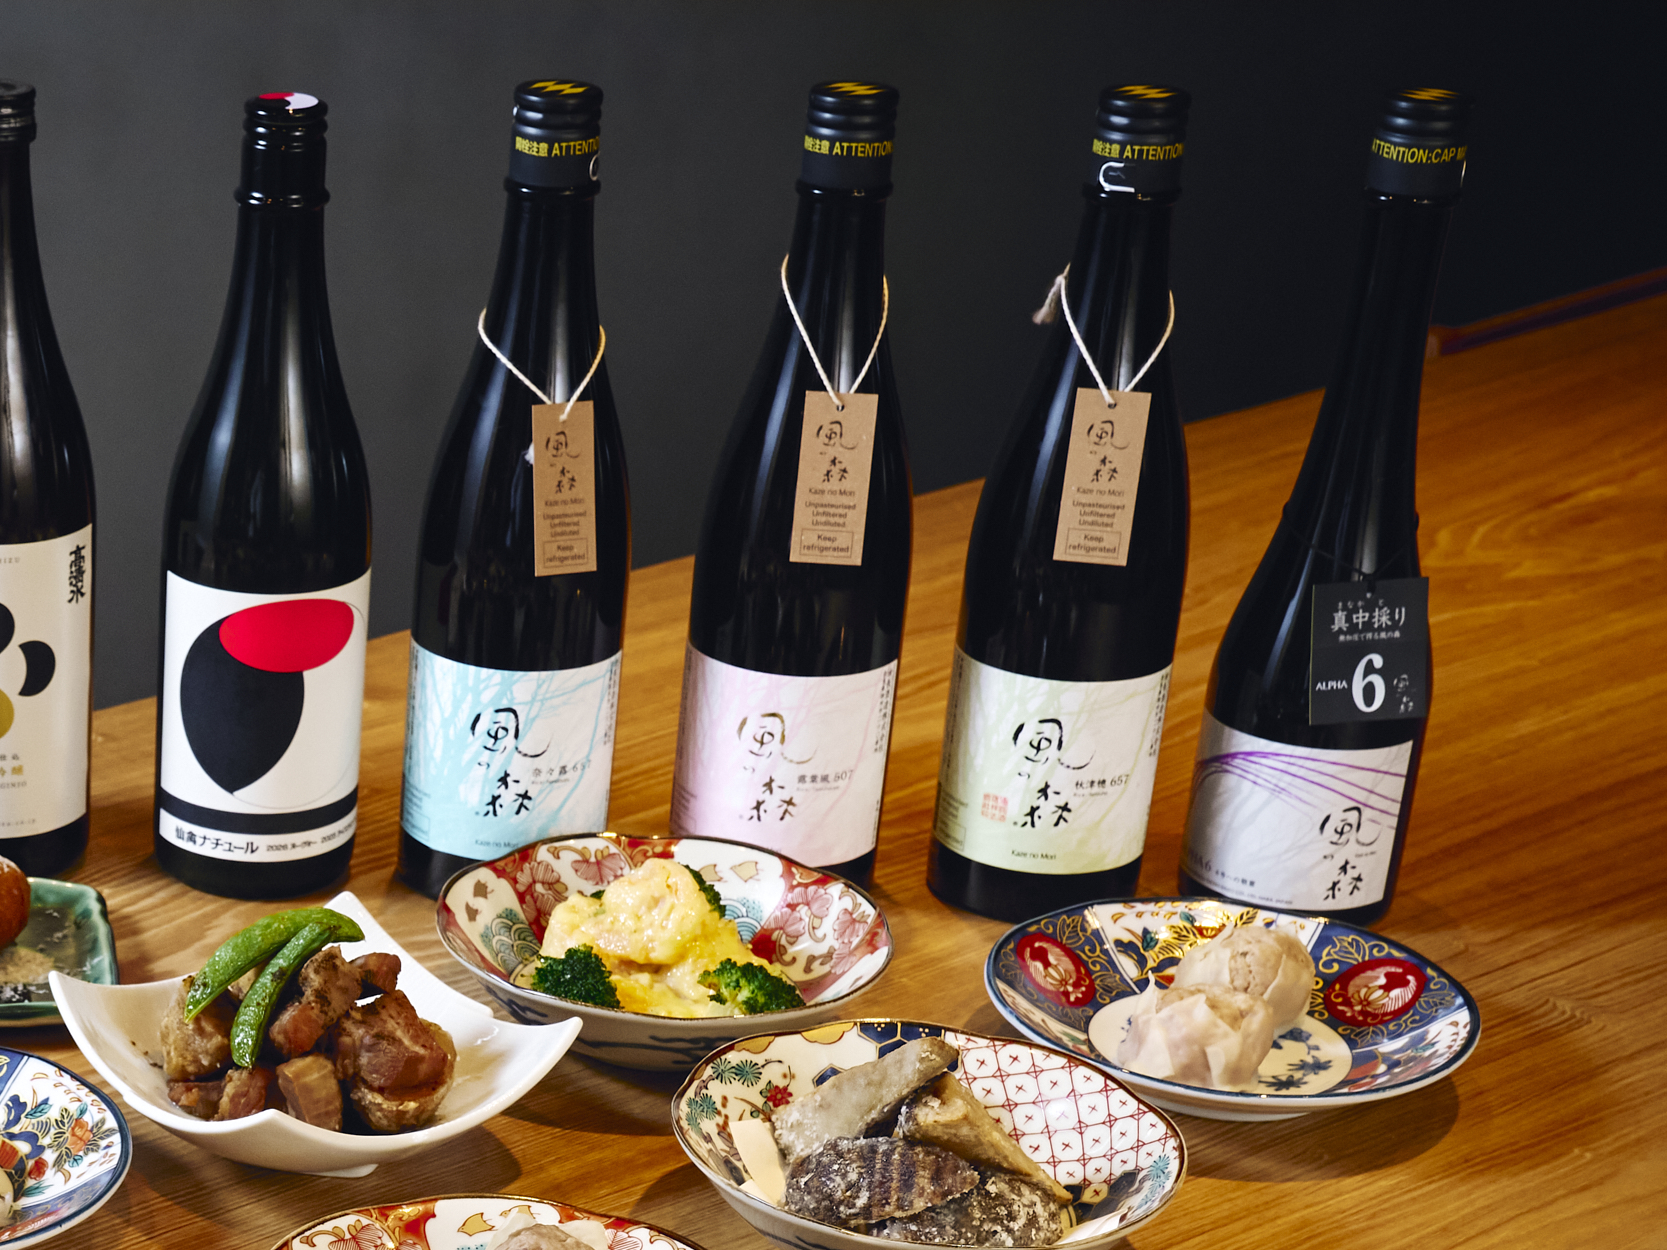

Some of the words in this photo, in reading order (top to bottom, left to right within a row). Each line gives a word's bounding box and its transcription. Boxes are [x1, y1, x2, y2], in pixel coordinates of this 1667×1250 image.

[809, 487, 825, 496] Kaze
[827, 488, 837, 496] no
[1076, 486, 1094, 495] Kaze
[1096, 488, 1107, 496] no
[812, 510, 848, 519] Unfiltered
[1079, 509, 1115, 519] Unfiltered
[812, 519, 846, 528] Undiluted
[1078, 519, 1114, 528] Undiluted
[817, 533, 838, 543] Keep
[1084, 533, 1104, 543] Keep
[803, 542, 850, 554] refrigerated
[1068, 542, 1117, 554] refrigerated
[1331, 606, 1406, 632] 真中採り
[1316, 680, 1348, 691] ALPHA
[1352, 653, 1386, 713] 6
[833, 769, 854, 783] 507
[1110, 774, 1130, 787] 657
[175, 825, 259, 854] 仙禽ナチュール
[475, 839, 491, 847] Kaze
[1011, 849, 1028, 858] Kaze
